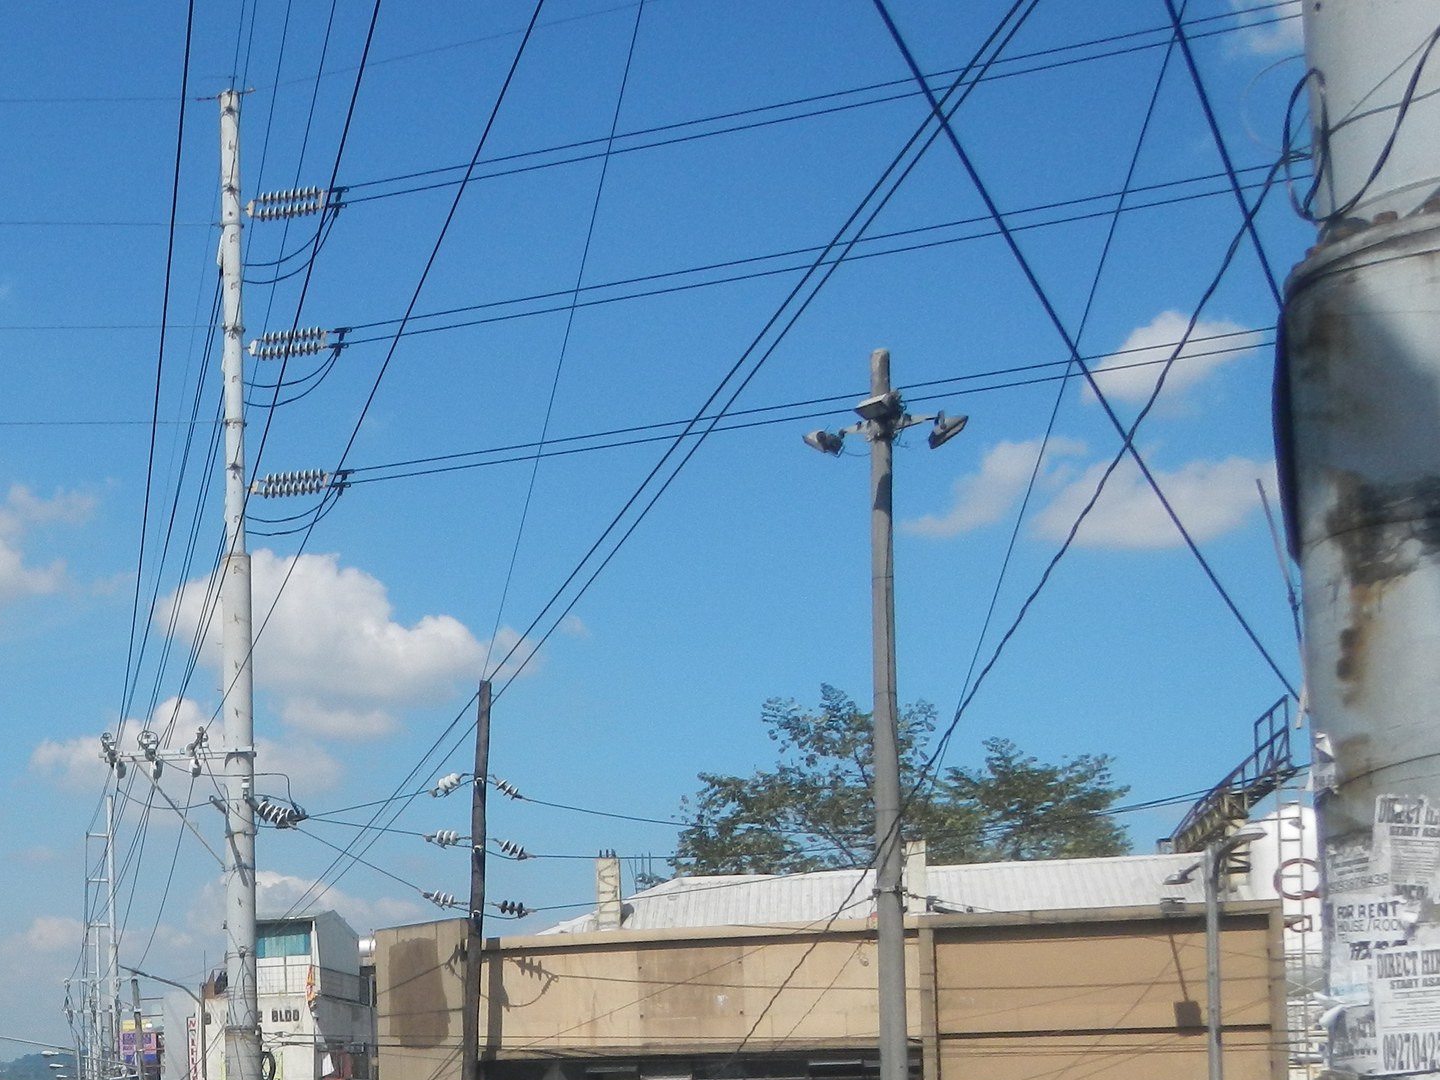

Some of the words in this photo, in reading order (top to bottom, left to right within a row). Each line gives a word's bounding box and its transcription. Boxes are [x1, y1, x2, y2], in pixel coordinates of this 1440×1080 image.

[1357, 901, 1400, 918] RENT
[1376, 951, 1418, 979] DIRECT
[1389, 979, 1418, 990] START
